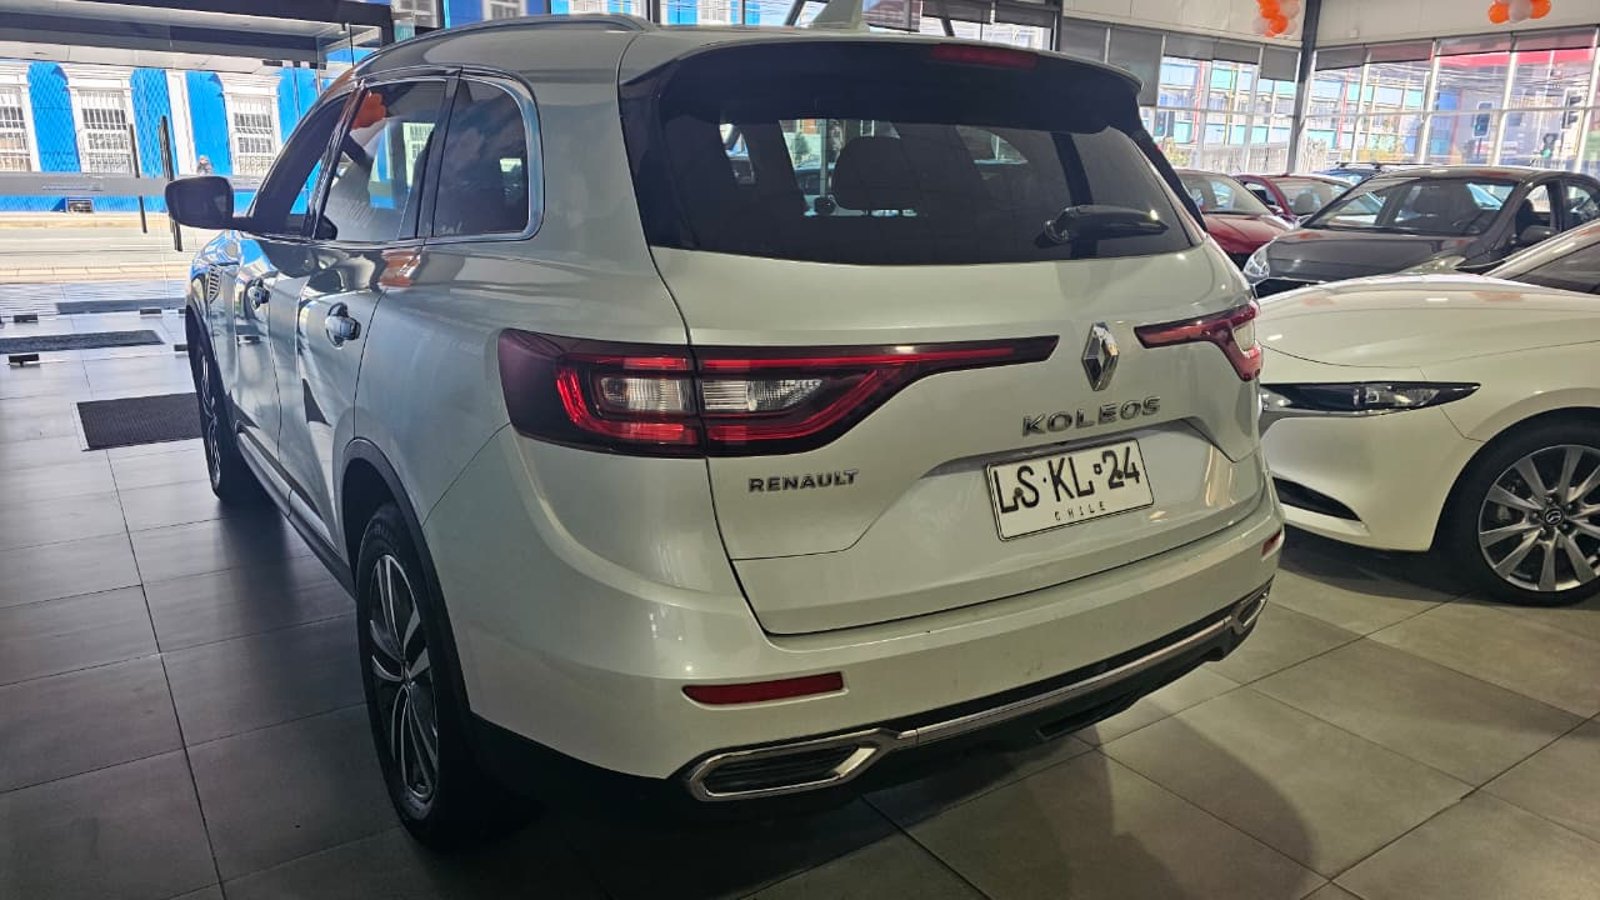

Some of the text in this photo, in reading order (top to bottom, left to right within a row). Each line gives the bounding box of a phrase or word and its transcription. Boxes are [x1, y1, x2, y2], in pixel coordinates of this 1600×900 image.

[1022, 396, 1160, 436] KOLEOS
[749, 469, 858, 492] RENAULT
[1054, 501, 1106, 521] CHILE
